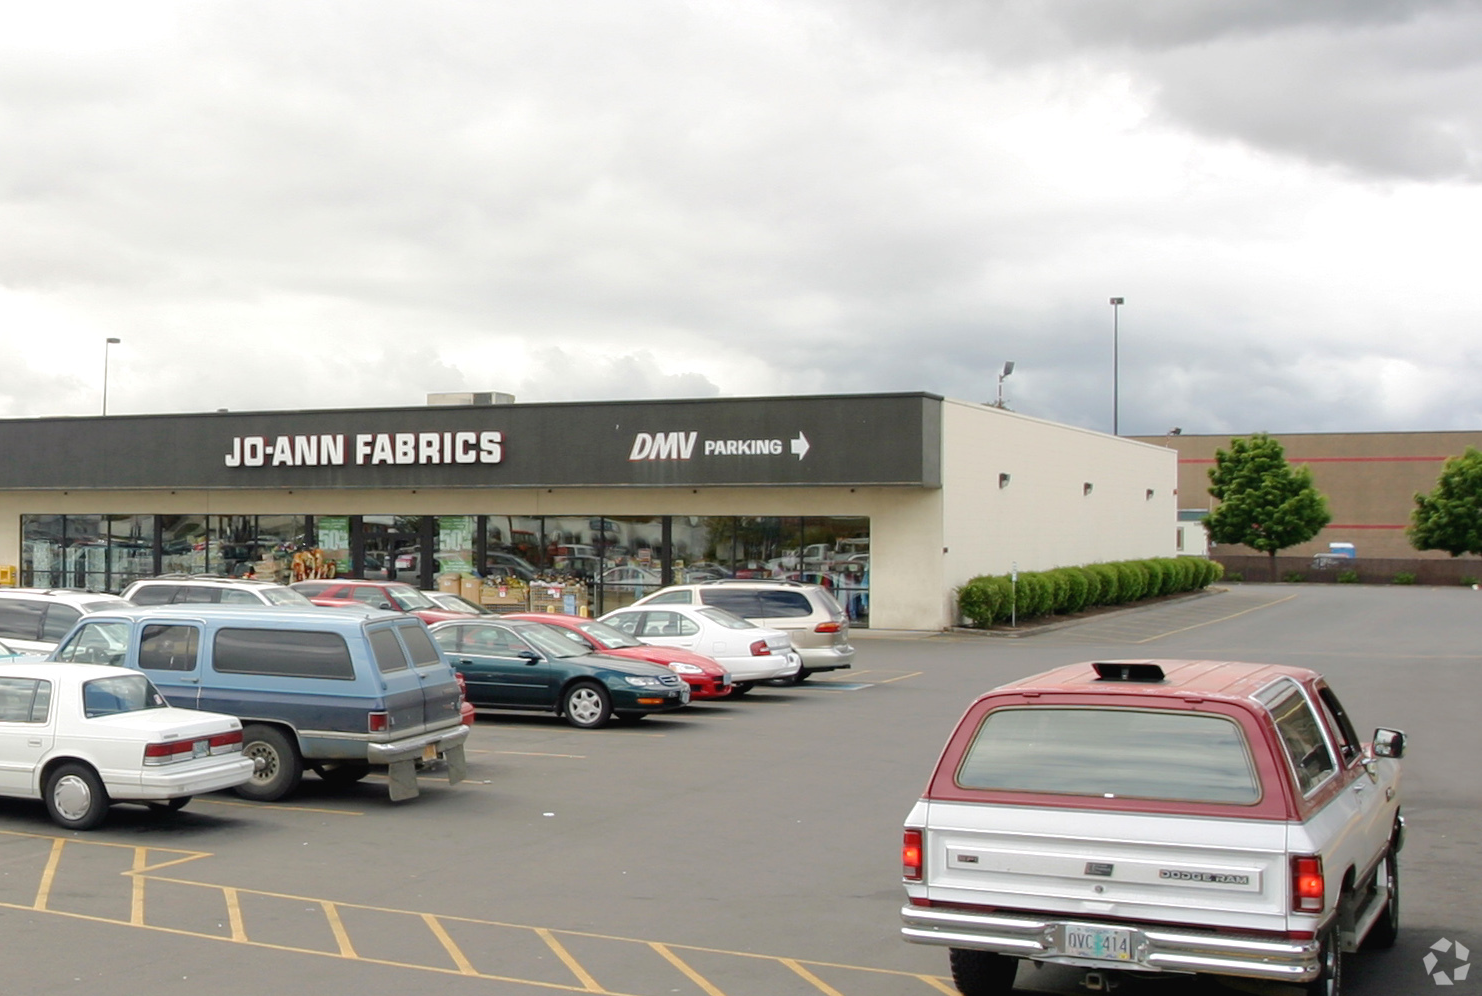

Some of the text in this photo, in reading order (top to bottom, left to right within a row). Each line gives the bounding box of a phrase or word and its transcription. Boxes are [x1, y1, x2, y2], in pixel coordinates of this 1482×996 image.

[224, 430, 504, 467] JO-ANN FABRICS
[628, 431, 783, 461] DMV PARKING
[1159, 869, 1250, 885] DODGE RAM
[1103, 936, 1127, 953] 414
